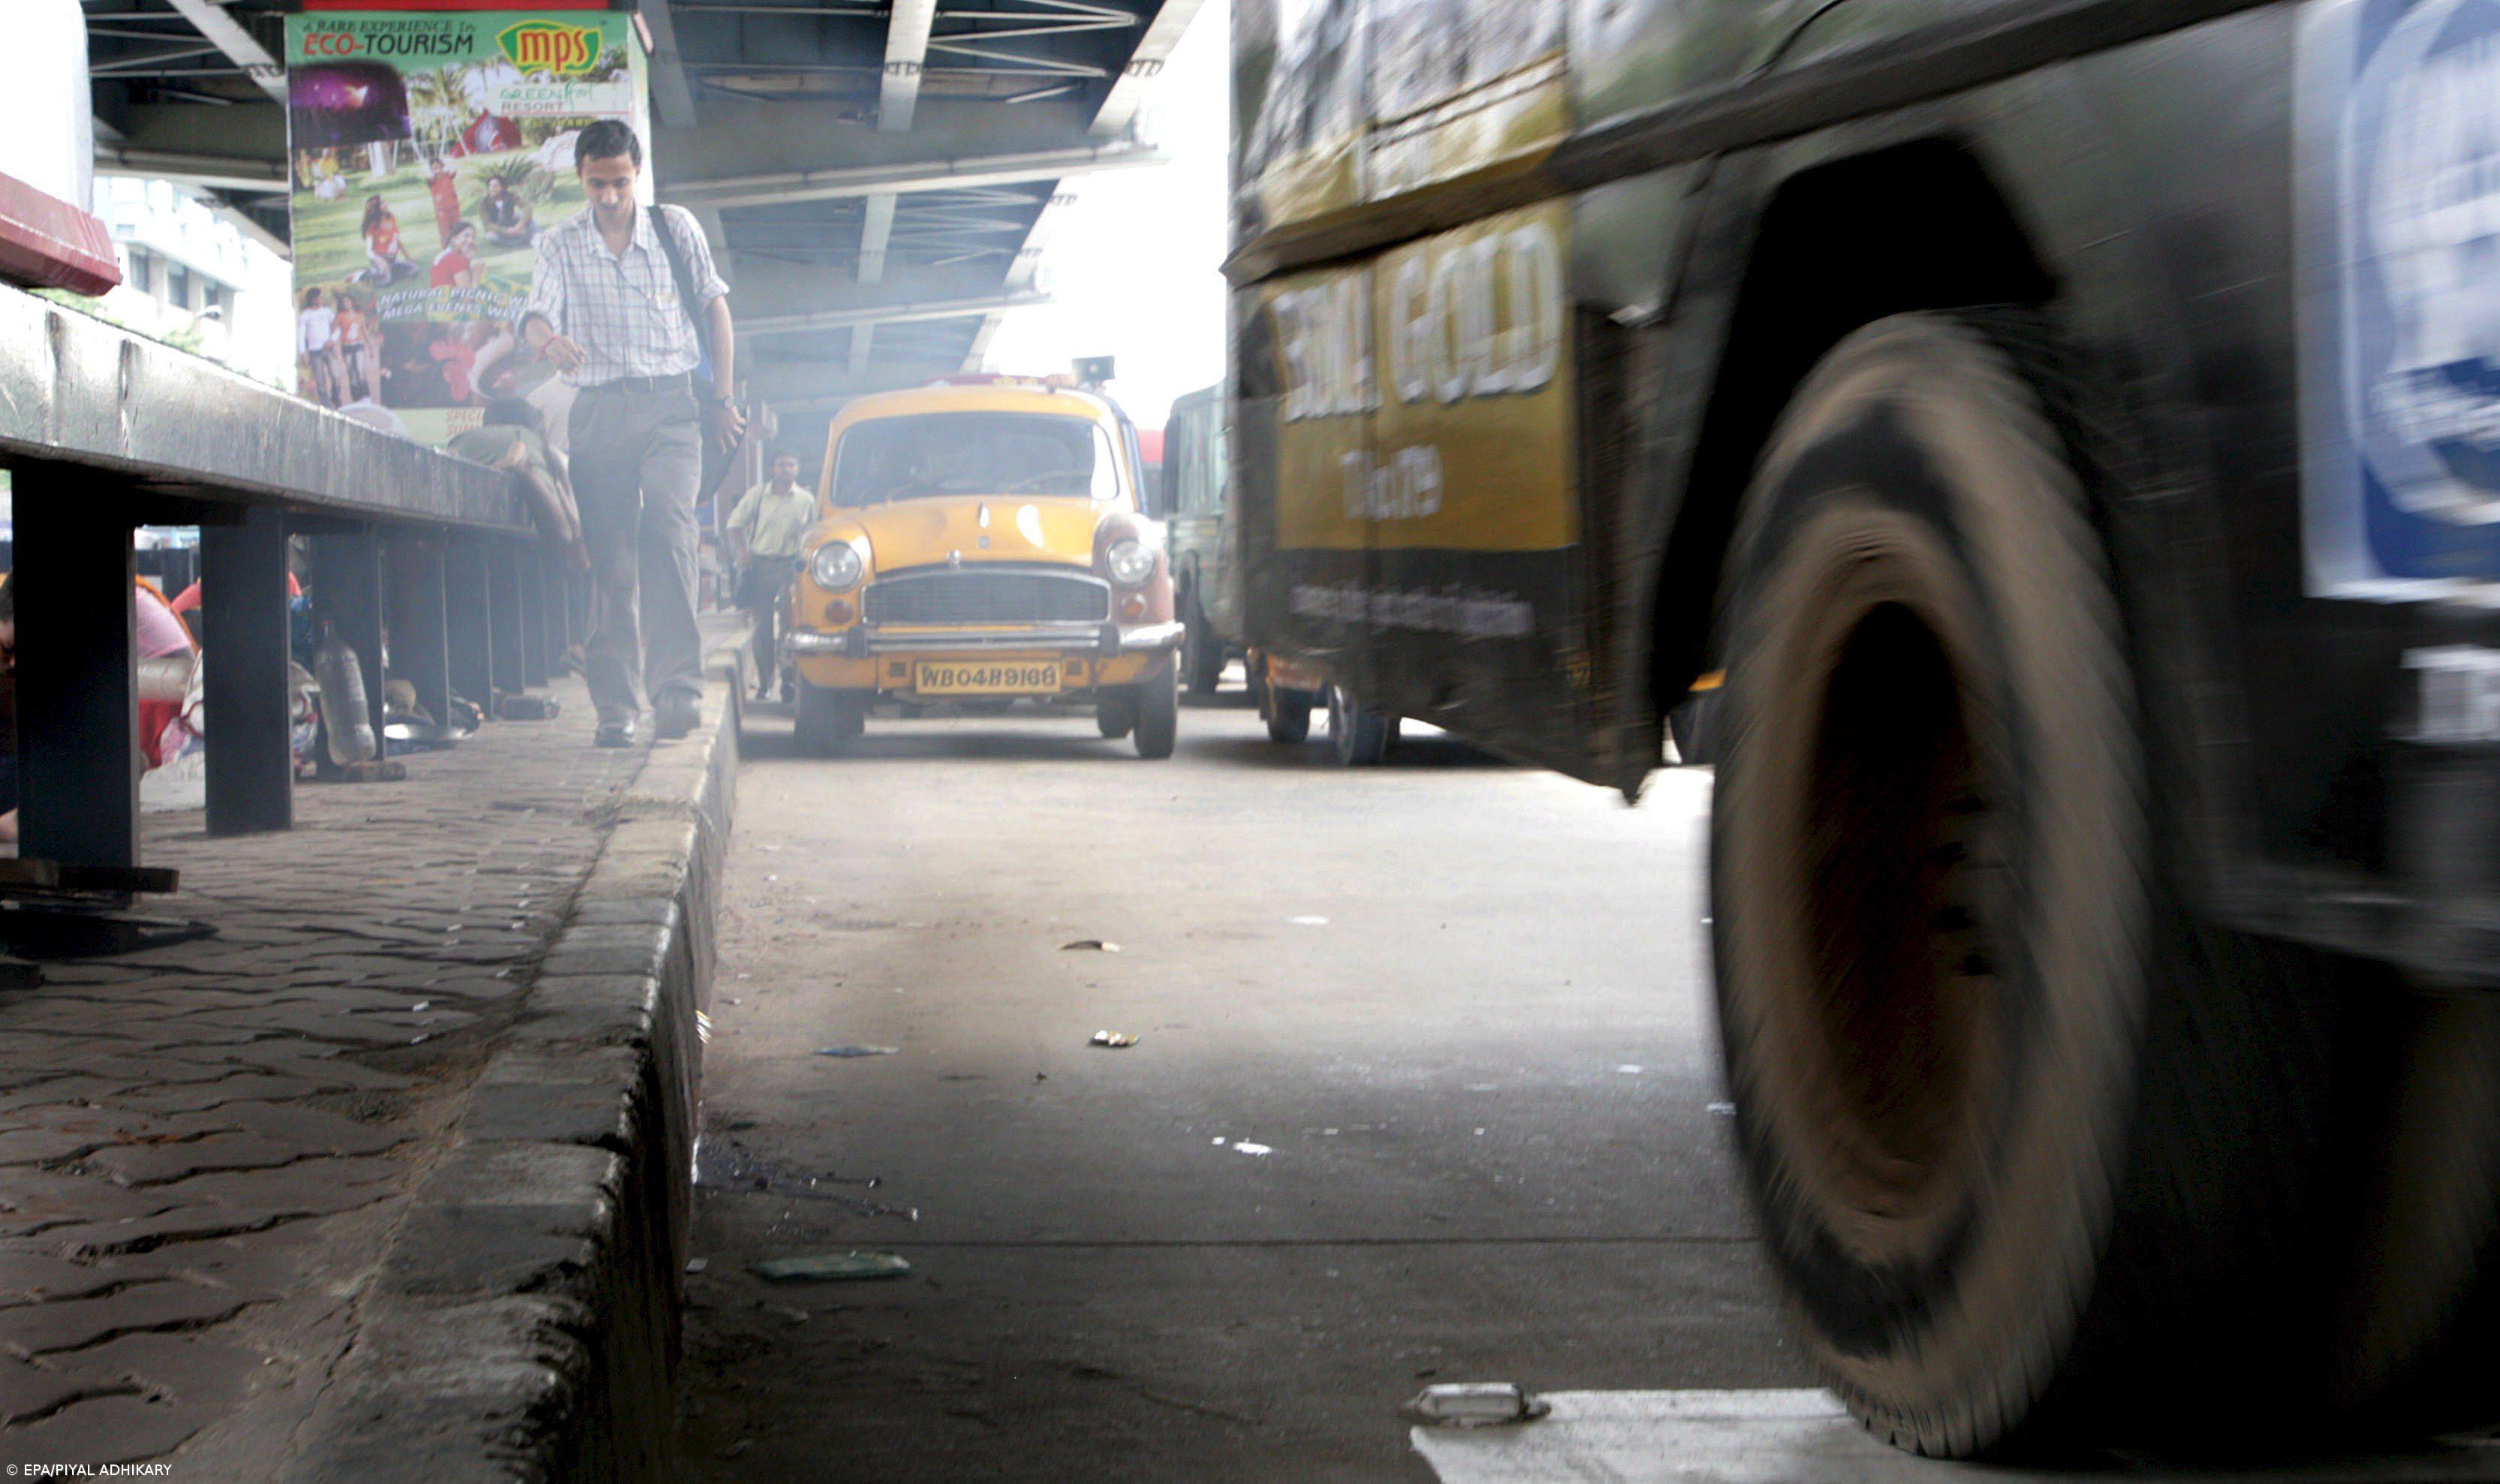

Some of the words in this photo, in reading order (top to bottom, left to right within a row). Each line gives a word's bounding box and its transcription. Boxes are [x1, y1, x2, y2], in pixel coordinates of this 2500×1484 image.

[303, 22, 312, 32] A
[316, 20, 357, 32] RARE
[360, 19, 451, 33] EXPERIENCE
[303, 32, 473, 56] ECO-TOURISM
[501, 101, 564, 112] RESORT
[381, 287, 444, 305] NATURAL
[382, 303, 422, 321] MEGA
[428, 300, 482, 312] EVENTS
